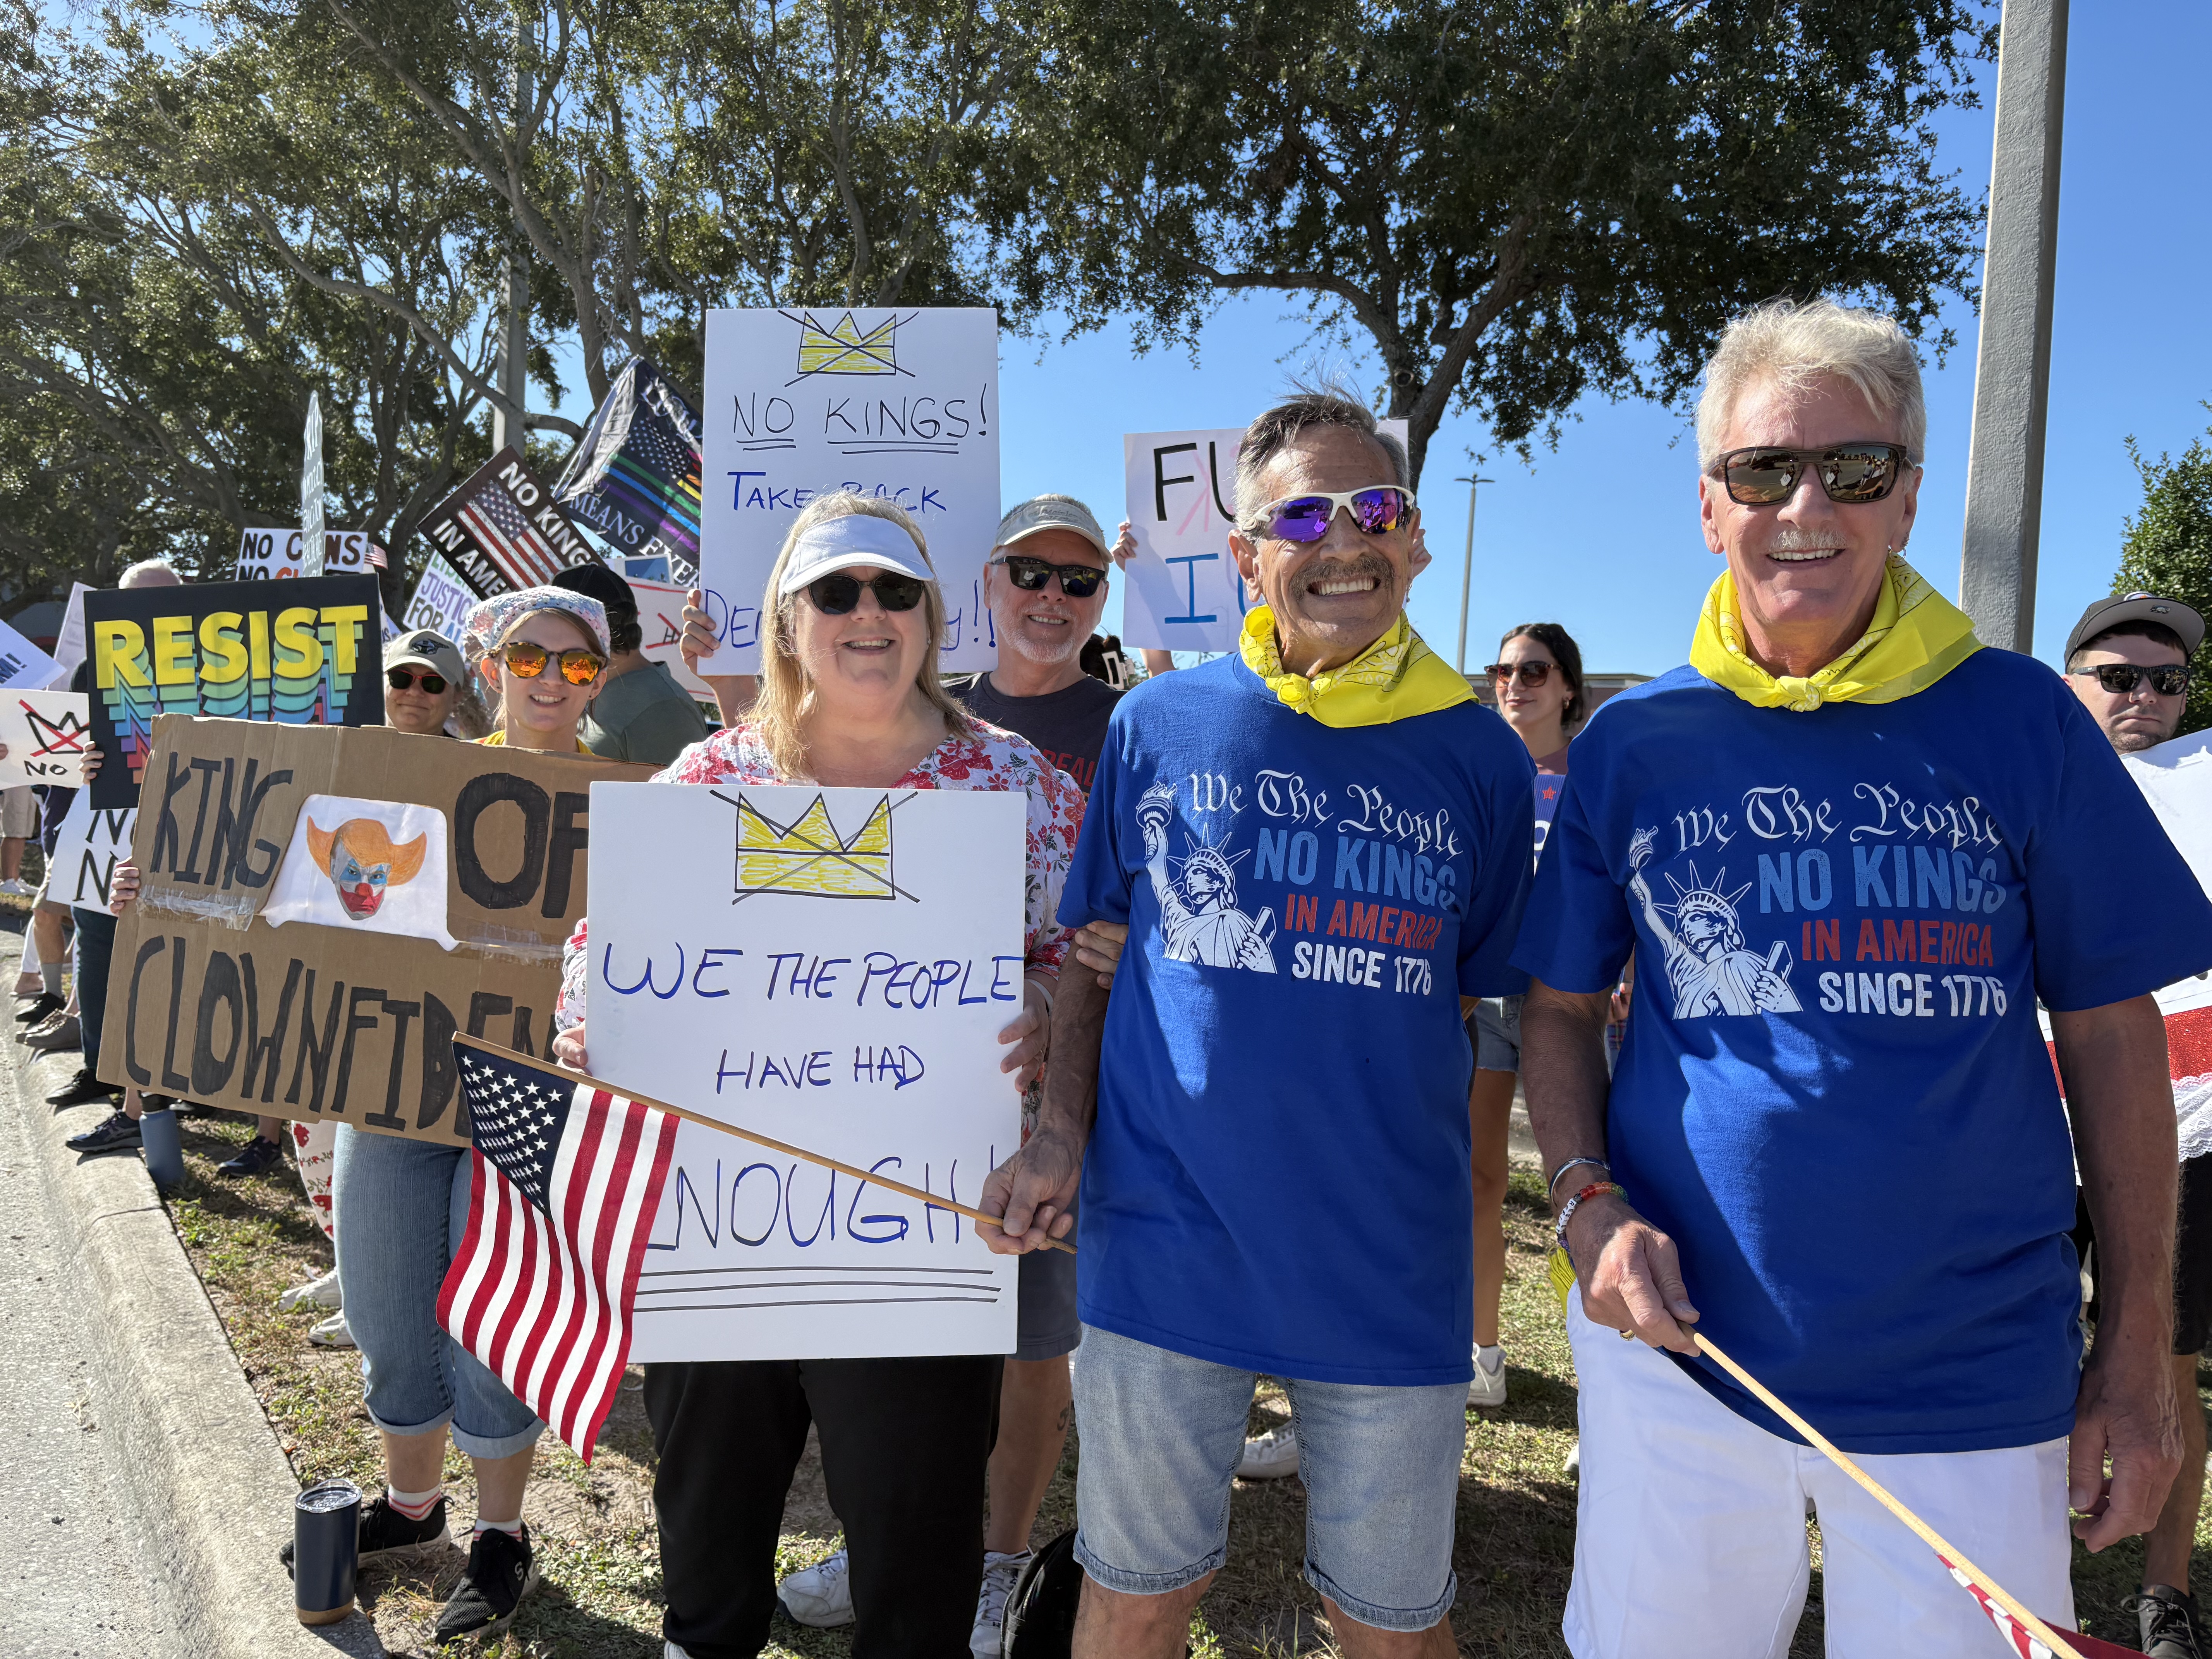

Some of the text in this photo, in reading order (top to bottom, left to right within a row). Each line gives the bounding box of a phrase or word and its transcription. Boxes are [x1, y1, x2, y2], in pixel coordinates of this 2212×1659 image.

[734, 392, 794, 436] NO
[825, 383, 987, 439] KINGS!
[499, 461, 591, 568] NO KING
[568, 493, 645, 544] MEANS
[242, 532, 362, 565] NO CNS
[433, 519, 465, 552] IN
[455, 549, 511, 599] AME
[407, 596, 444, 632] FOR
[421, 572, 473, 626] JUSTIC
[94, 605, 368, 689] RESIST
[24, 761, 67, 775] NO
[149, 751, 589, 918] KING OF
[1186, 769, 1248, 820] We
[1255, 769, 1333, 828] The
[1337, 783, 1464, 862] People
[1672, 781, 2003, 860] We The People
[1254, 827, 1317, 885] NO
[1333, 836, 1457, 911] KINGS
[1757, 845, 2008, 914] NO KINGS
[1284, 893, 1443, 950] IN AMERICA
[1802, 919, 1993, 967] IN AMERICA
[603, 941, 1025, 1009] WE THE PEOPLE
[1291, 941, 1432, 996] SINCE 1776
[1819, 972, 2008, 1017] SINCE 1776
[716, 1045, 925, 1094] HAVE HAD
[647, 1144, 994, 1251] NOUGH
